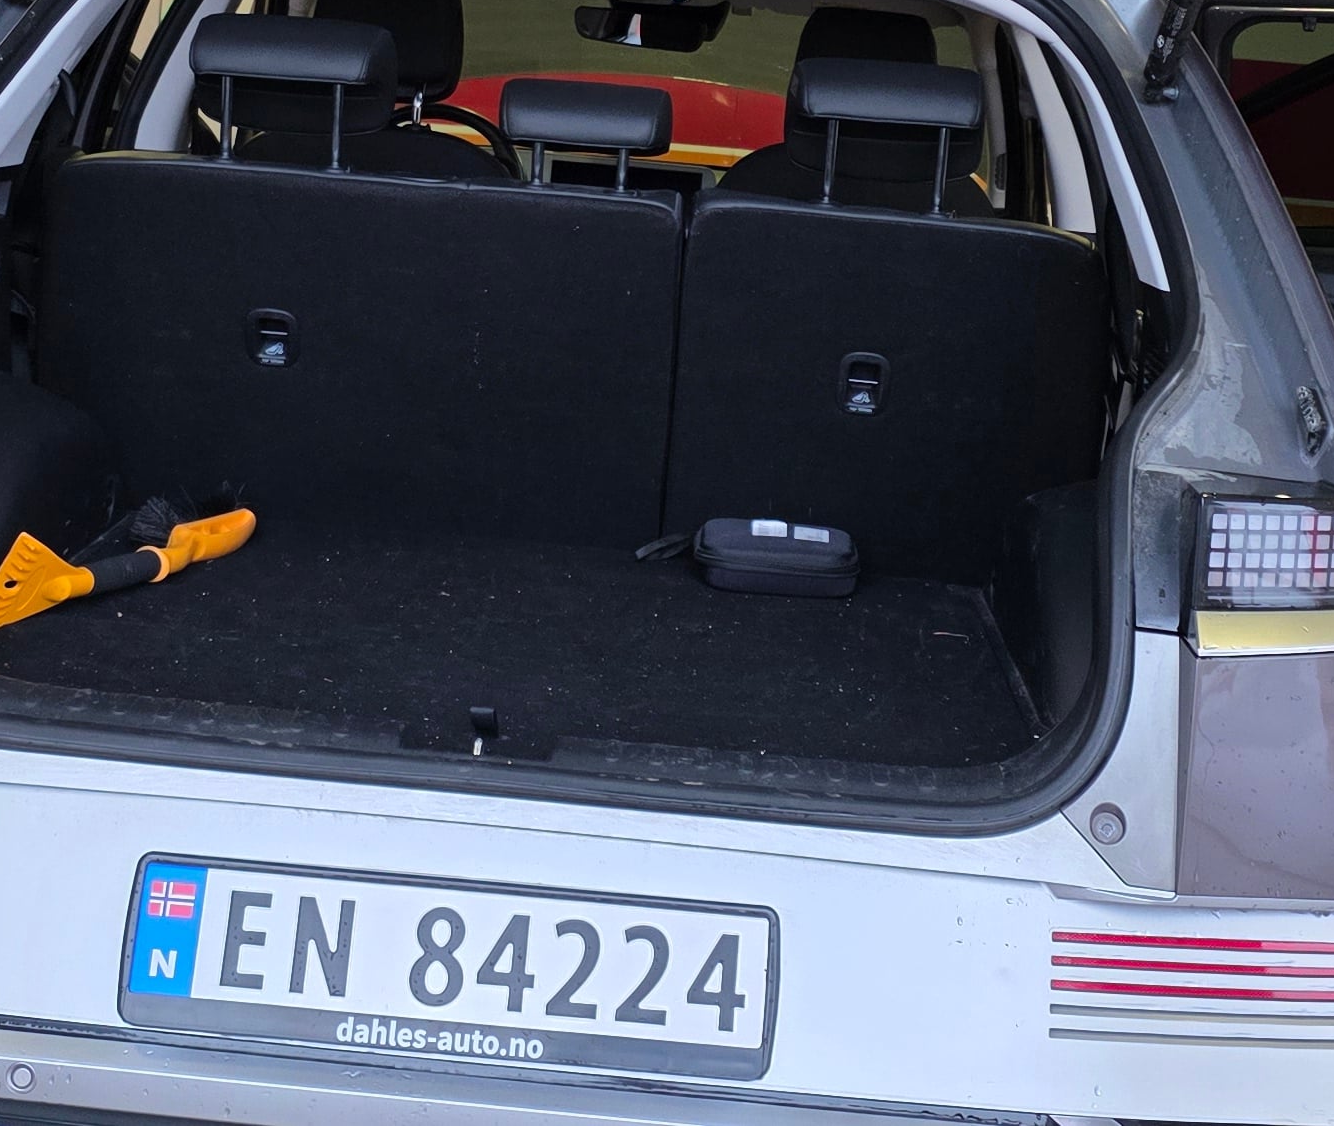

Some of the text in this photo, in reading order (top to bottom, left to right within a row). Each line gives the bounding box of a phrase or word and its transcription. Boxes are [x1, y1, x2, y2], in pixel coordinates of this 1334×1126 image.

[148, 948, 178, 979] N
[219, 890, 746, 1032] EN 84224
[336, 1016, 544, 1060] dahles-auto.no
